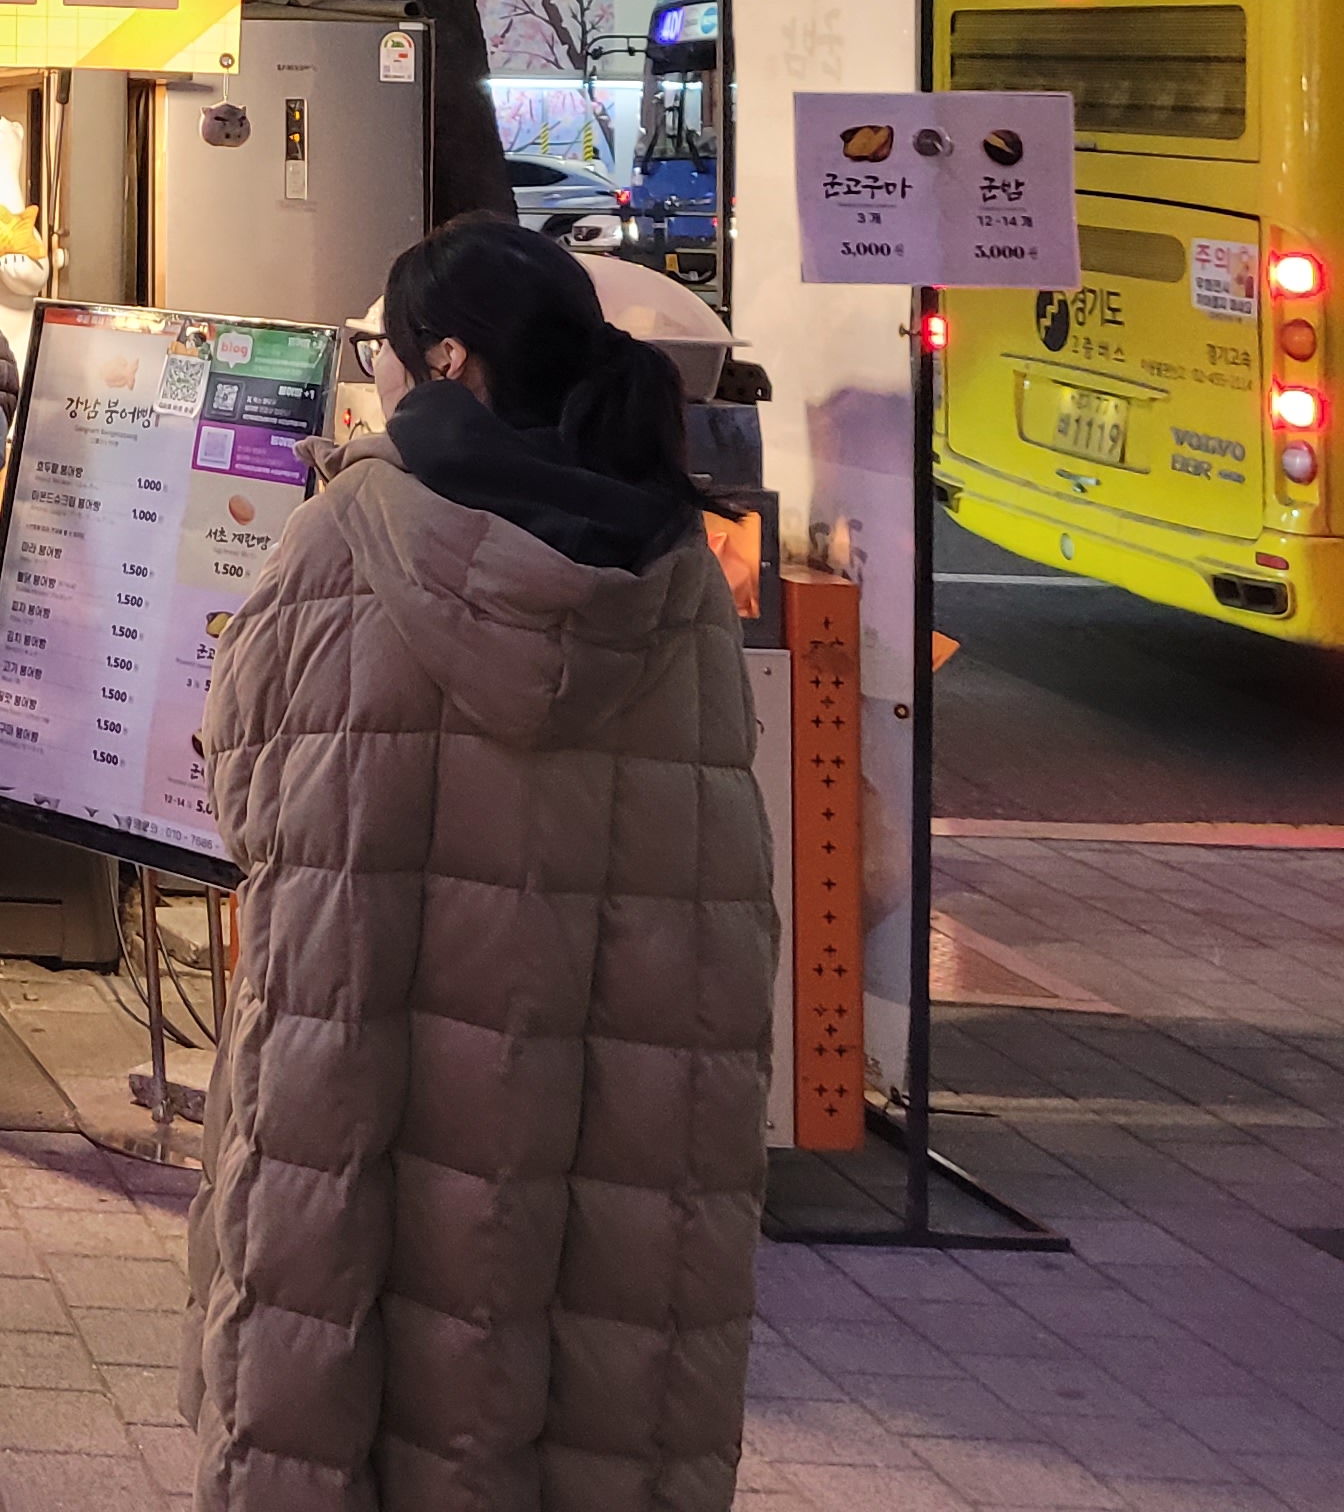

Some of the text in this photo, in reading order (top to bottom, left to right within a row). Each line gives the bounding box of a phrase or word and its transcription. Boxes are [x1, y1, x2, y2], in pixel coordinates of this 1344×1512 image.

[823, 173, 1025, 202] 군고구마 군밤
[1195, 244, 1231, 274] 주의
[1071, 286, 1125, 327] 경기도
[221, 342, 248, 357] blog
[65, 396, 102, 420] 강남
[104, 399, 156, 429] 붕어빵
[205, 527, 228, 543] 서초
